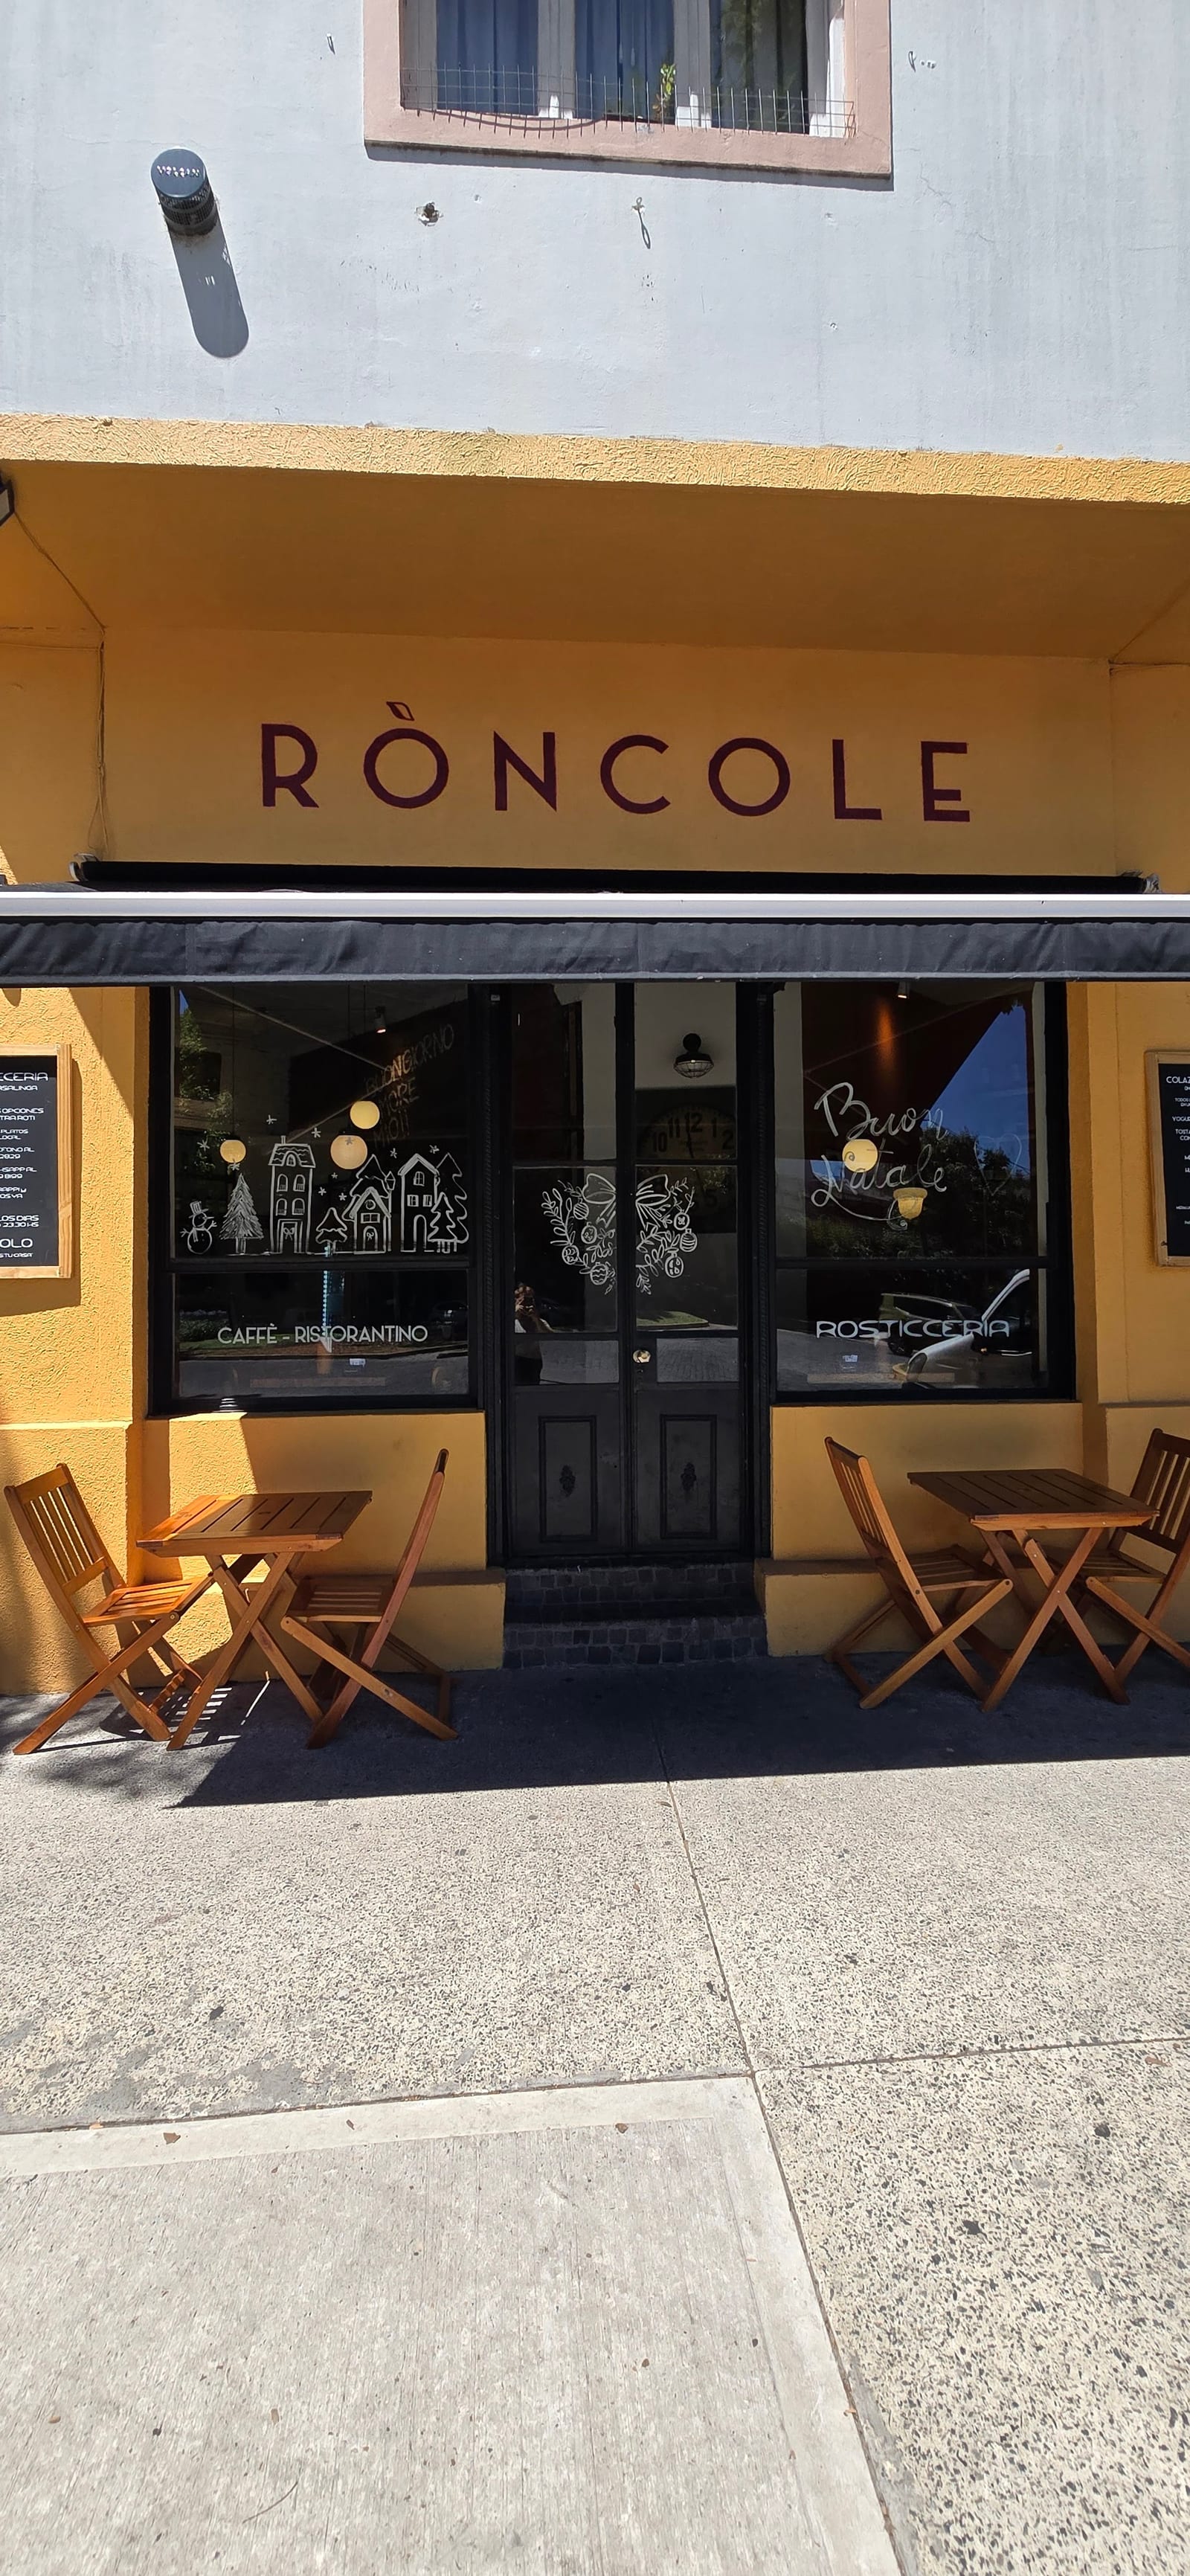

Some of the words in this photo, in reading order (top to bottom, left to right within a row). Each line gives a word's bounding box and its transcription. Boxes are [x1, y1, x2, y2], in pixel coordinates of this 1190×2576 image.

[261, 701, 971, 822] RÒNCOLE
[684, 1112, 703, 1132] 12
[814, 1082, 948, 1142] Buon
[811, 1138, 948, 1231] Natale
[217, 1323, 278, 1344] CAFFÈ
[295, 1325, 428, 1343] RISTORANTINO
[816, 1320, 1011, 1338] ROSTICCERIA
